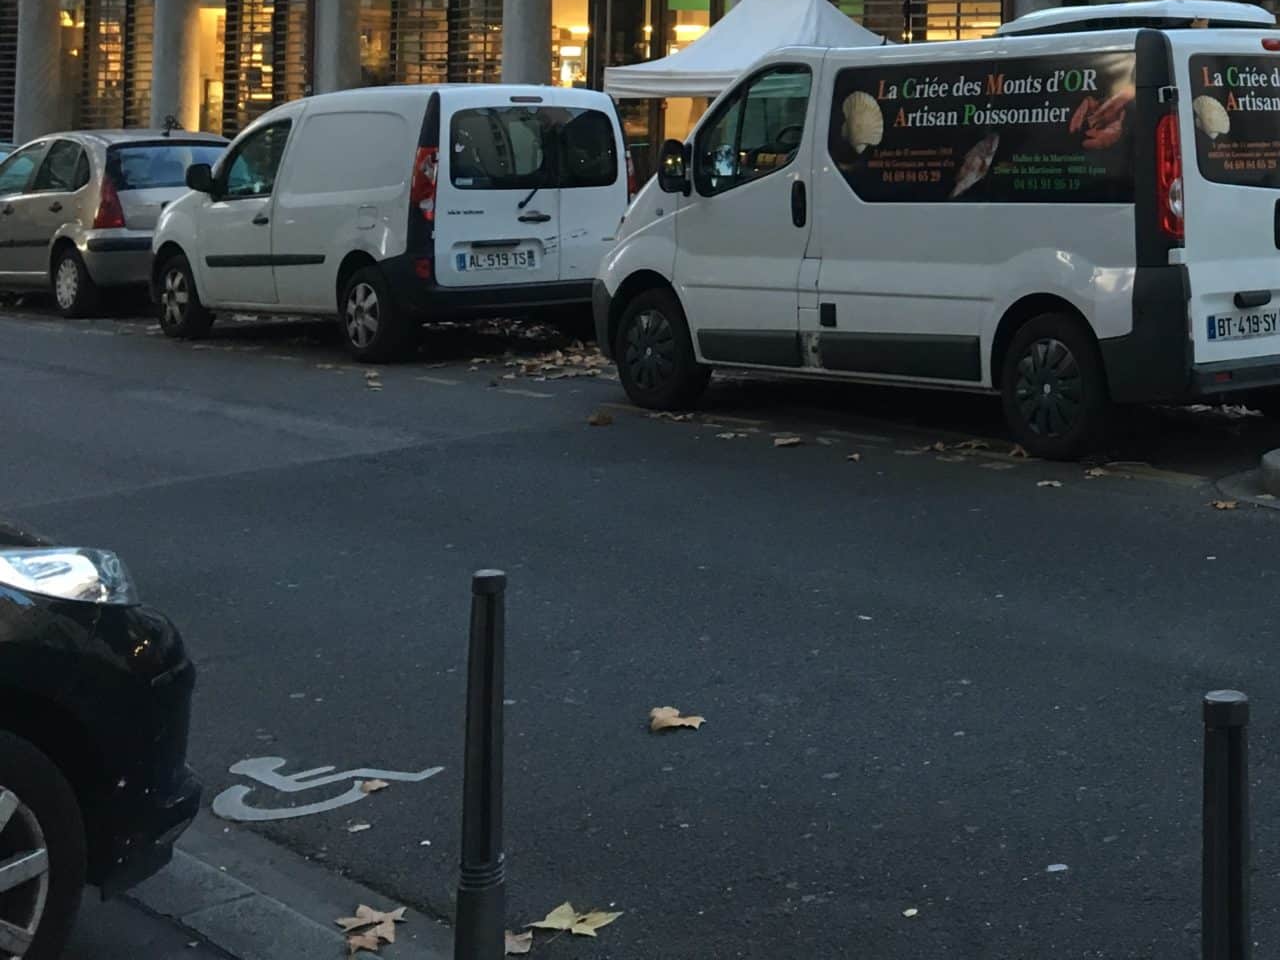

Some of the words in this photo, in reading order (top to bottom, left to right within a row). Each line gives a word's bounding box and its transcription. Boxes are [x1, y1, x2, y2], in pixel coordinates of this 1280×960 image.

[877, 79, 898, 100] La
[902, 77, 949, 99] Criée
[952, 75, 982, 97] des
[986, 73, 1043, 96] Monts
[1045, 68, 1099, 93] d'OR
[1201, 65, 1224, 88] La
[1226, 65, 1268, 88] Criée
[892, 106, 958, 128] Artisan
[962, 100, 1071, 126] Poissonnier
